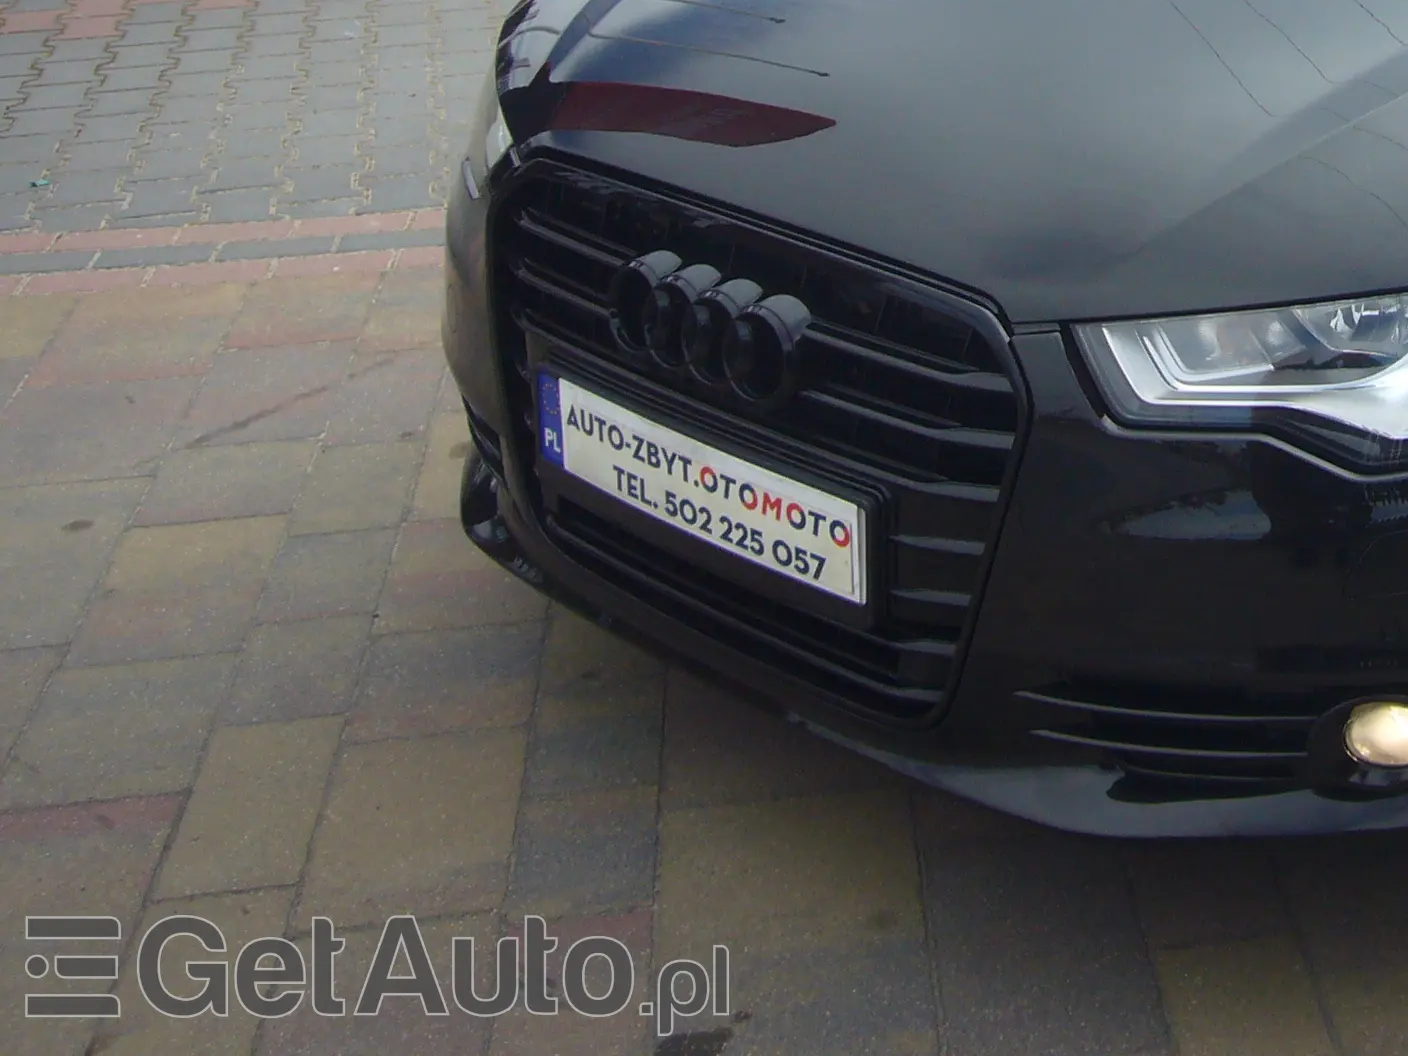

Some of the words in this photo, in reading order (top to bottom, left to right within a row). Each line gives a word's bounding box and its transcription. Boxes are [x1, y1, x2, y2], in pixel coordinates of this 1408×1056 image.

[544, 427, 562, 454] PL
[566, 404, 851, 548] AUTO-ZBYT.OTOMOTO
[612, 464, 659, 510] TEL.
[664, 490, 713, 535] 502
[718, 516, 766, 557] 225
[772, 540, 827, 582] 057
